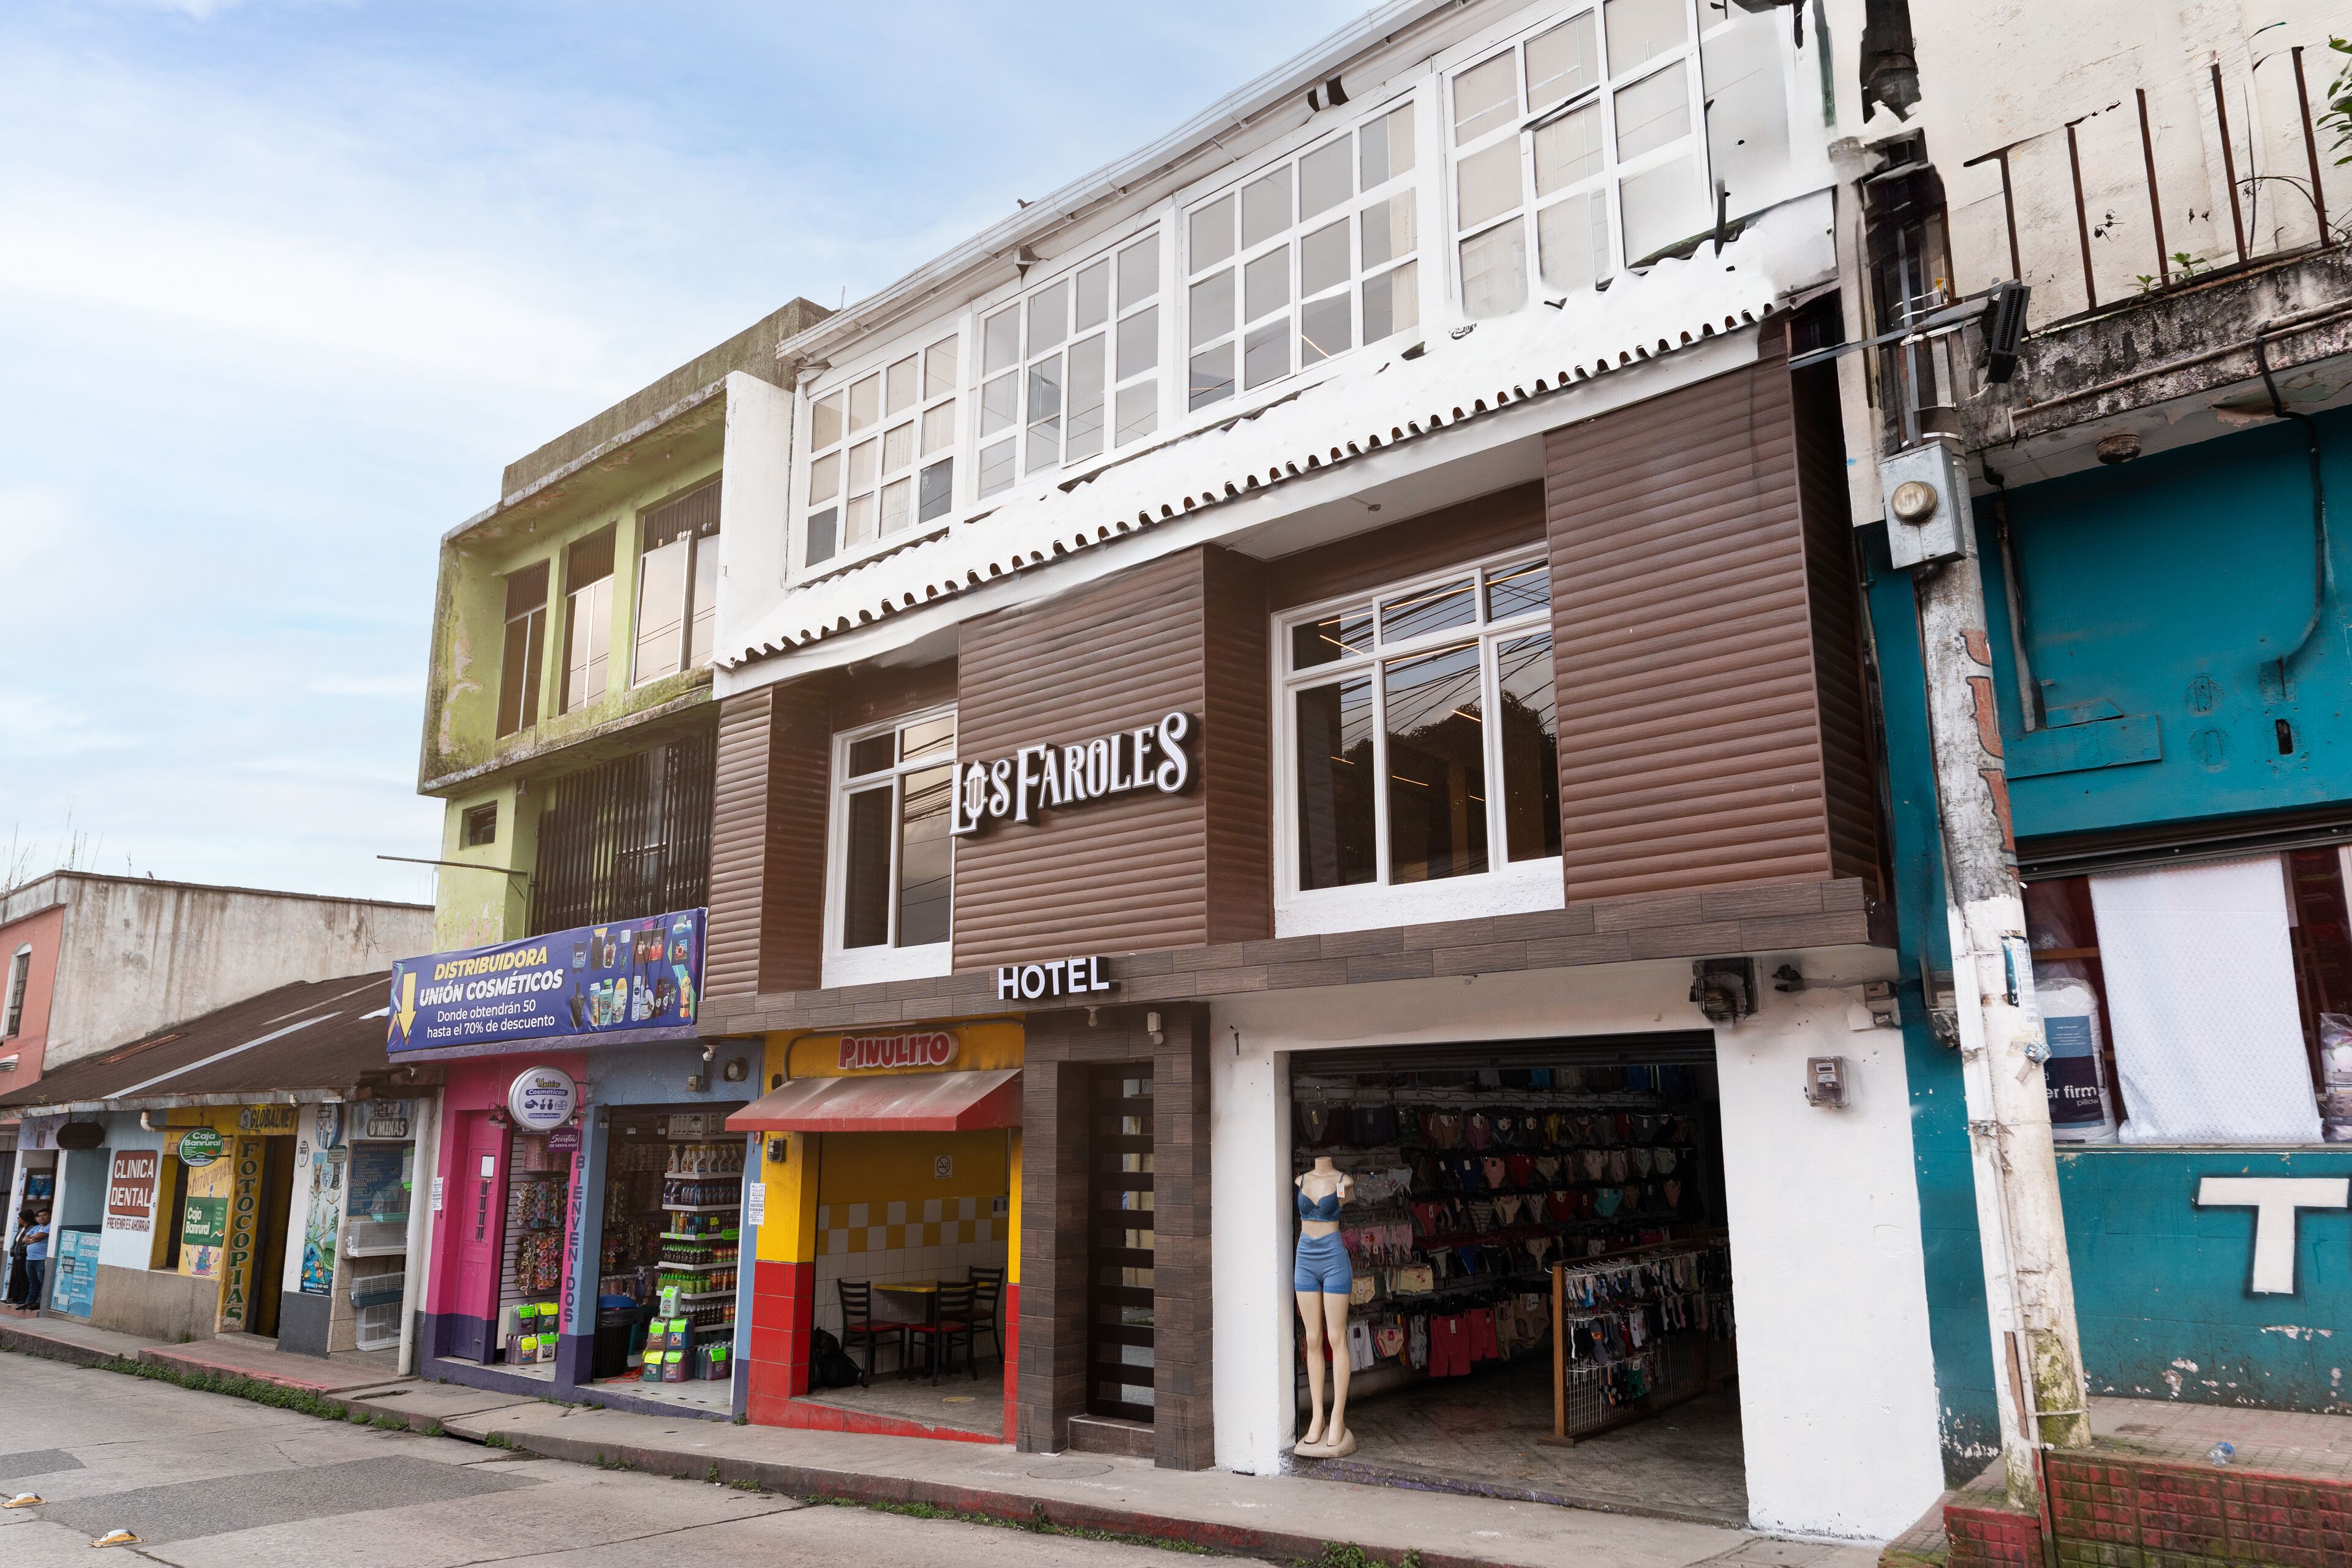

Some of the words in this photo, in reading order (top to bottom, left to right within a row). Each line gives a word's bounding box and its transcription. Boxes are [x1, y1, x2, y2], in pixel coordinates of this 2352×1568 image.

[950, 760, 1011, 835] LOS
[1014, 711, 1189, 823] FAROLES
[434, 946, 547, 981] DISTRIBUIDORA
[420, 981, 464, 1006] UNIÓN
[466, 969, 564, 1000] COSMÉTICOS
[998, 956, 1110, 1000] HOTEL
[437, 1008, 467, 1022] Donde
[470, 1001, 520, 1018] obtendrán
[522, 999, 536, 1012] 50
[427, 1027, 451, 1038] hasta
[454, 1023, 462, 1035] el
[464, 1022, 483, 1034] 70%
[486, 1020, 498, 1031] de
[500, 1015, 555, 1030] descuento
[838, 1031, 951, 1069] PINULITO
[535, 1078, 560, 1088] Unión
[2064, 1085, 2097, 1099] firm
[2077, 1098, 2100, 1107] pillow
[192, 1132, 216, 1141] Caja
[369, 1120, 405, 1136] D'MINAS
[114, 1159, 154, 1179] CLINICA
[110, 1187, 151, 1207] DENTAL
[187, 1207, 202, 1223] Caja
[186, 1221, 210, 1235] Banrural
[225, 1141, 259, 1322] FOTOCOPIAS
[564, 1155, 585, 1323] BIENVENIDOS
[2198, 1177, 2350, 1294] T
